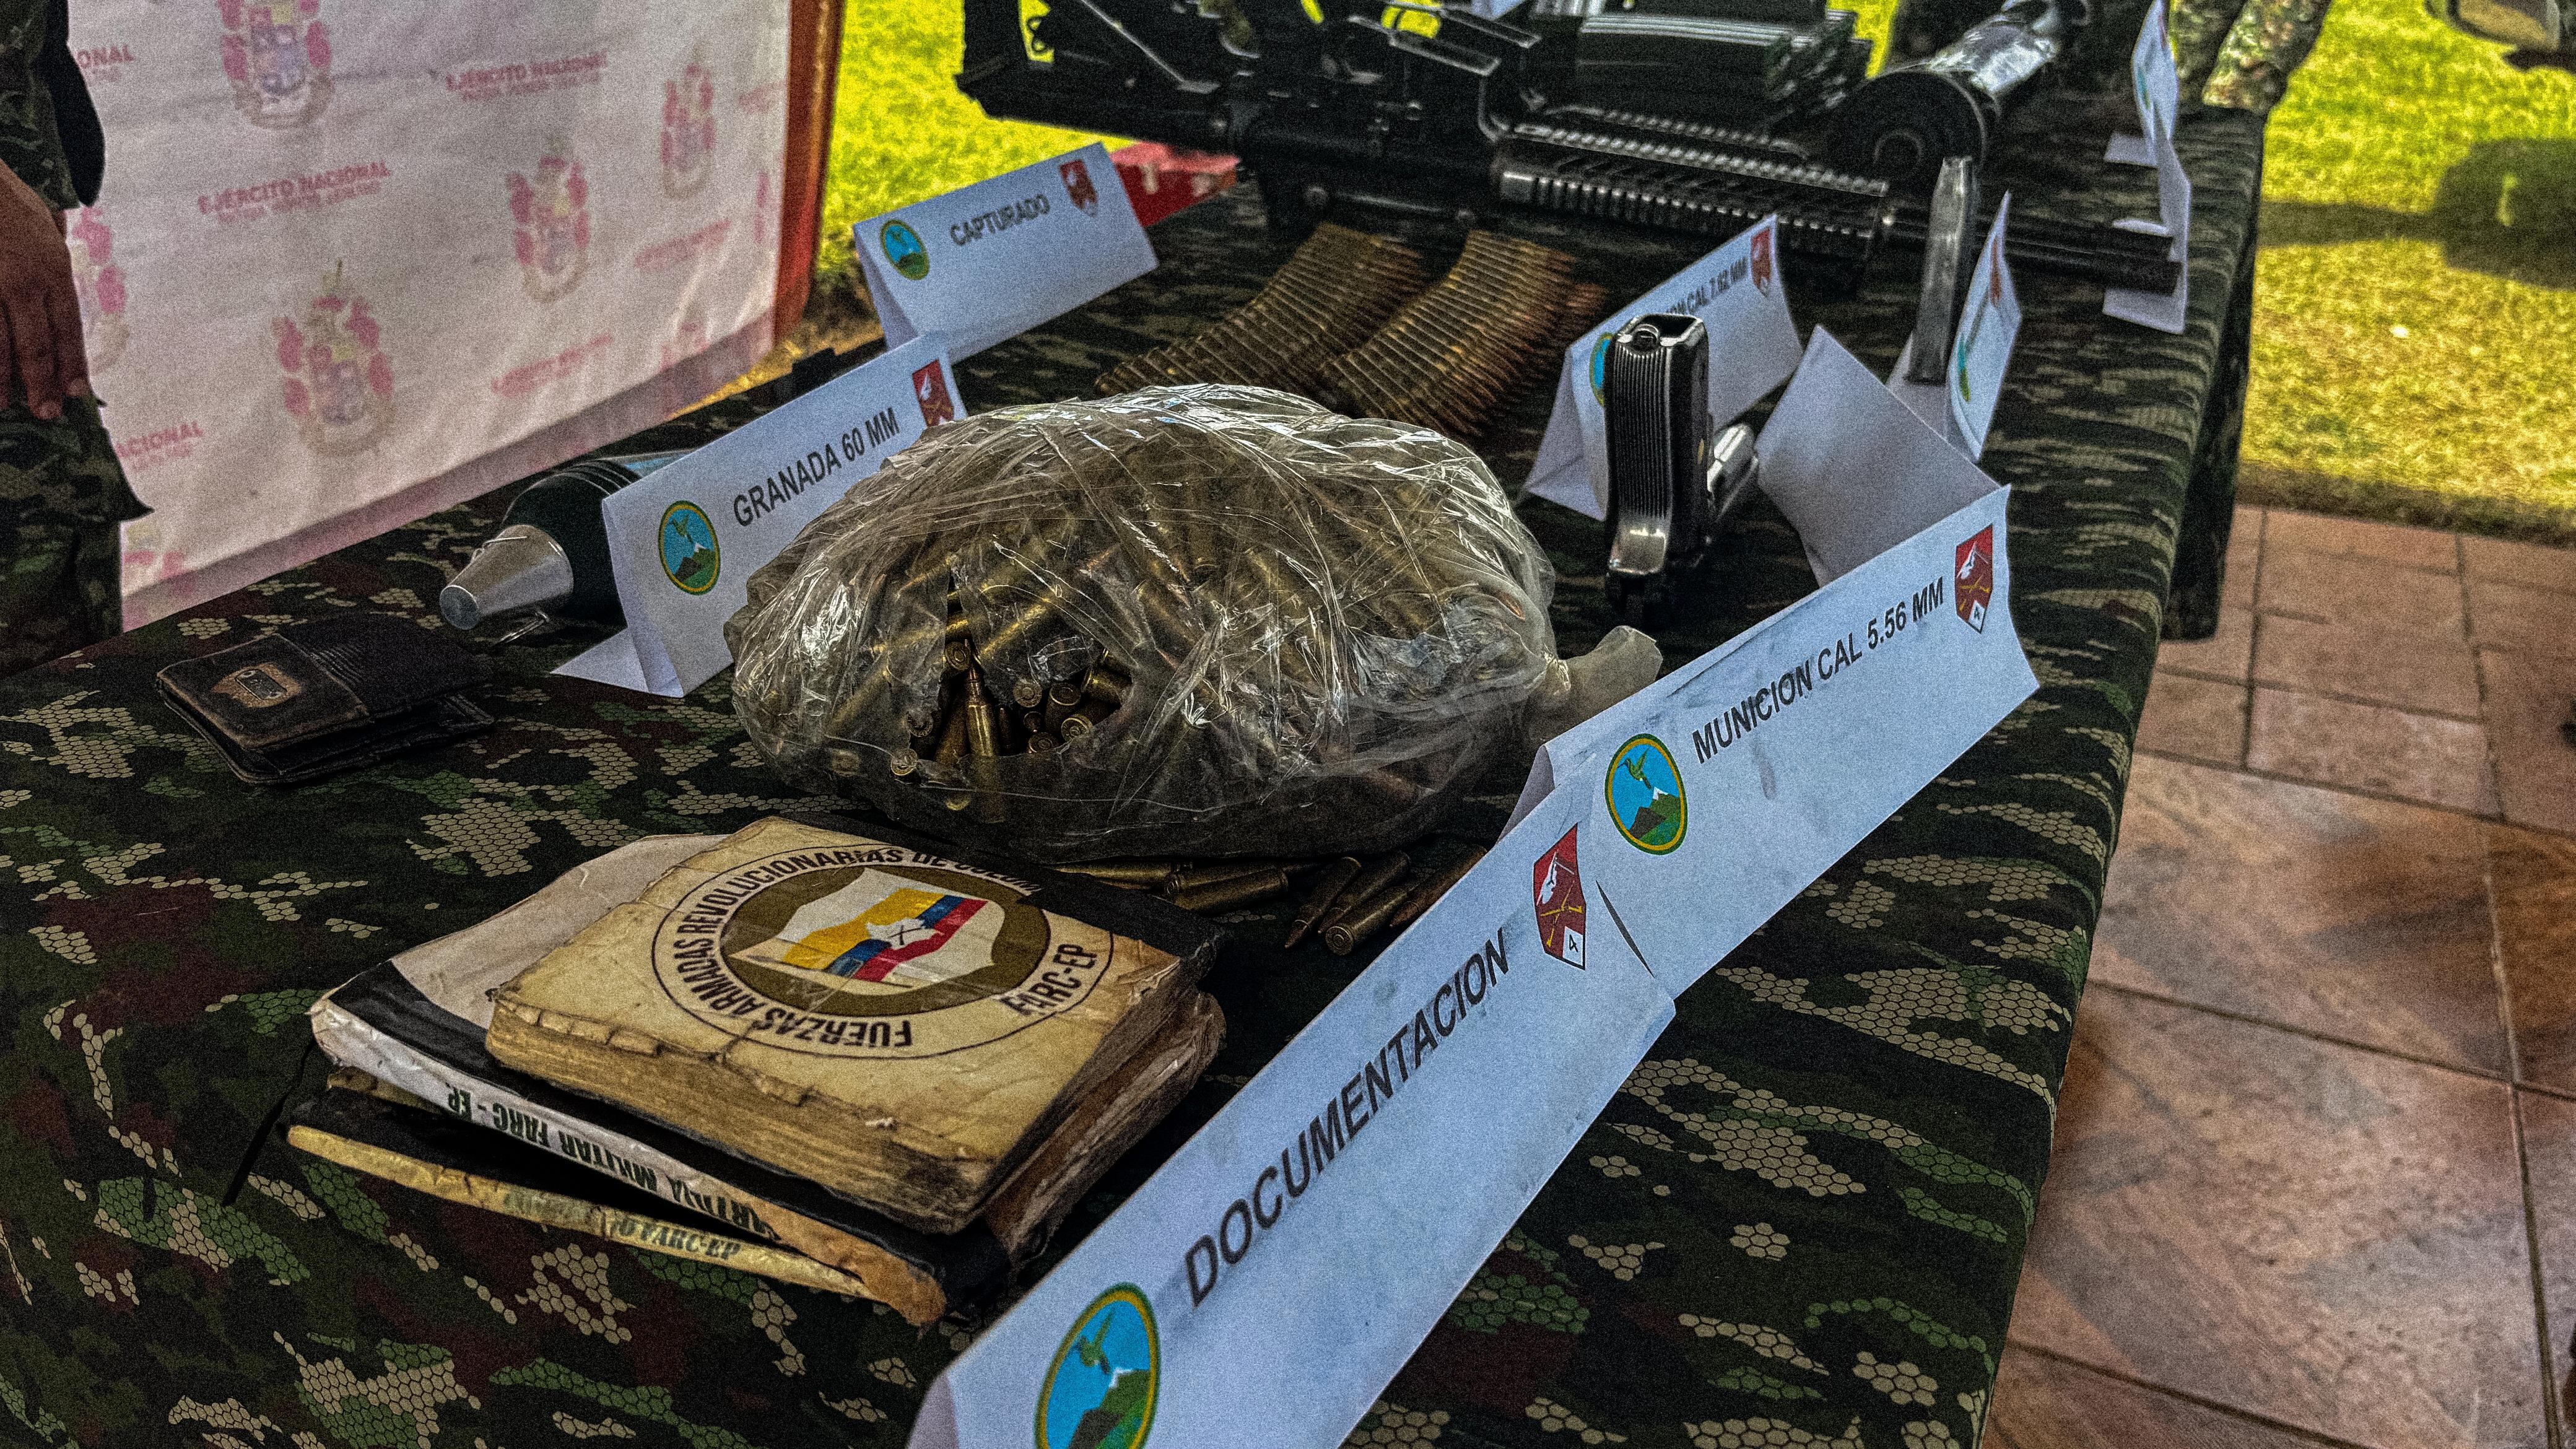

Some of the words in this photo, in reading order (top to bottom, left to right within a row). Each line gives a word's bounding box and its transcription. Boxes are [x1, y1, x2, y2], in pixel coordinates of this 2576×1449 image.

[77, 45, 134, 69] ONAL
[951, 194, 1050, 246] CAPTURADO
[1687, 285, 1709, 313] CAL
[1731, 256, 1747, 284] MM
[733, 444, 841, 526] GRANADA
[842, 427, 865, 462] 60
[864, 407, 900, 448] MM
[1692, 660, 1814, 764] MUNICION
[1817, 633, 1863, 680] CAL
[1868, 601, 1907, 651] 5.56
[1912, 577, 1944, 622] MM
[676, 848, 903, 934] REVOLUCIONARIAS
[673, 937, 766, 1019] ARMADAS
[1001, 944, 1098, 1015] FARC-EP
[757, 1007, 912, 1048] FUERZAS
[494, 1102, 552, 1147] FARC
[1185, 928, 1509, 1308] DOCUMENTACION
[557, 1131, 658, 1192] MILITAR
[640, 1223, 741, 1261] FARC-EP
